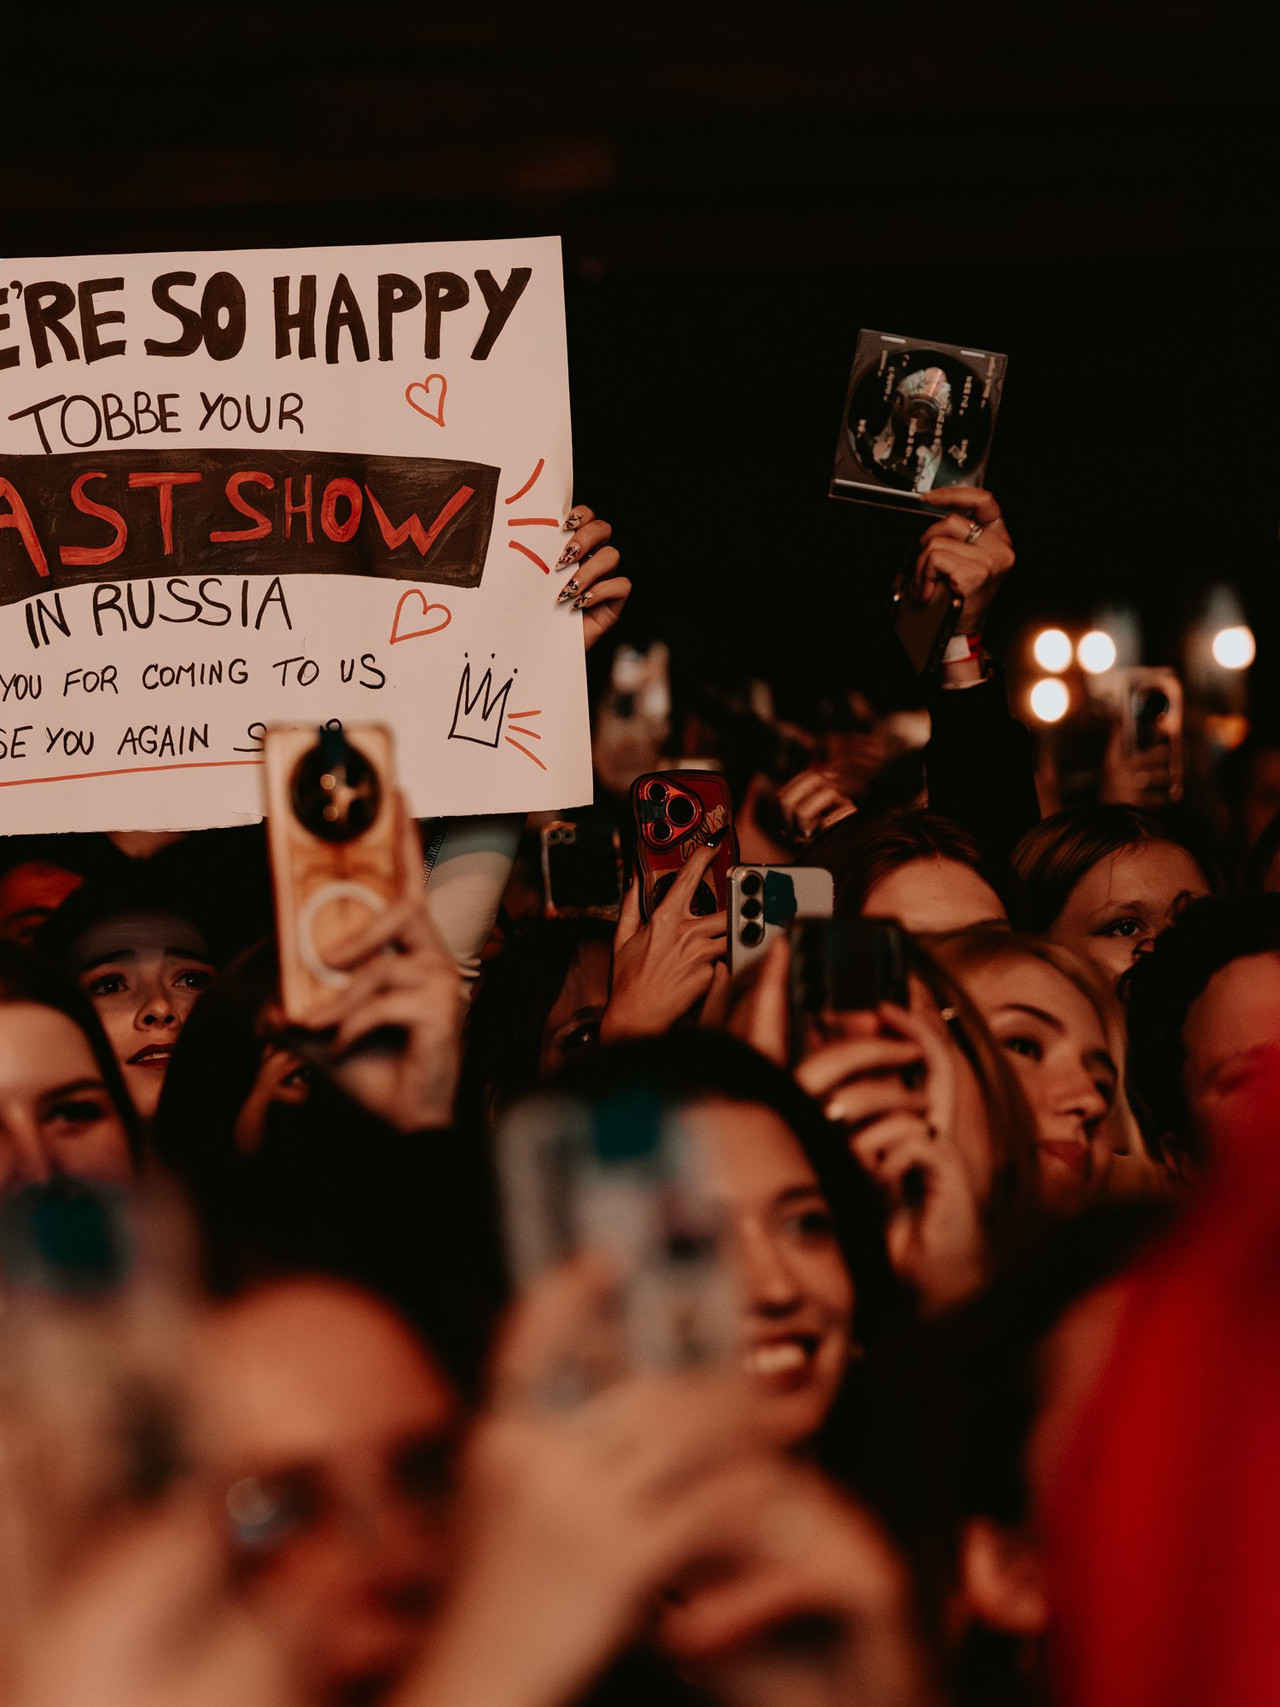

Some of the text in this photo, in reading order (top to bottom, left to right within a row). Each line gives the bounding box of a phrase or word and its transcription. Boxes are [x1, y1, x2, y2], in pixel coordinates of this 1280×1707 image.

[144, 271, 246, 361] SO
[273, 268, 532, 364] HAPPY
[199, 392, 304, 434] YOUR
[210, 471, 475, 556] SHOW
[25, 577, 292, 649] IN RUSSIA
[63, 665, 118, 696] FOR
[142, 658, 249, 690] COMING
[272, 656, 319, 687] TO
[341, 653, 385, 689] US
[46, 727, 94, 756] YOU
[117, 723, 209, 757] AGAIN
